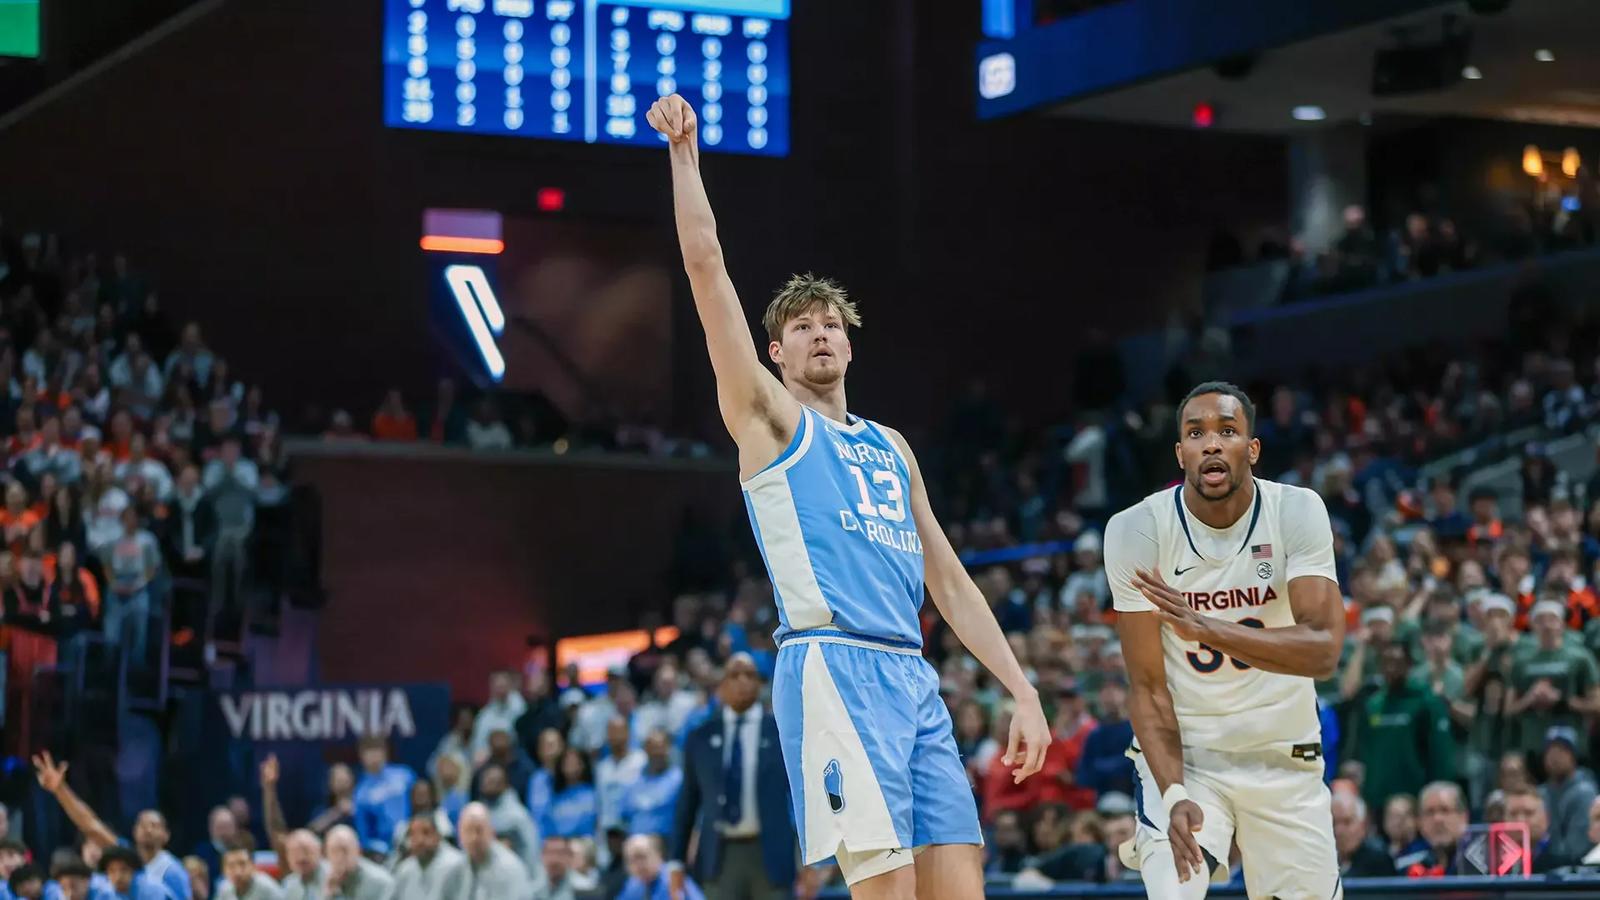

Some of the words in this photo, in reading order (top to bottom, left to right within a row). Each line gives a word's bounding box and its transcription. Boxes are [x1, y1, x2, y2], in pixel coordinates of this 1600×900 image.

[834, 441, 897, 472] NORTH
[849, 465, 906, 523] 13
[840, 510, 923, 554] CROLIN
[219, 687, 416, 740] VIRGINIA
